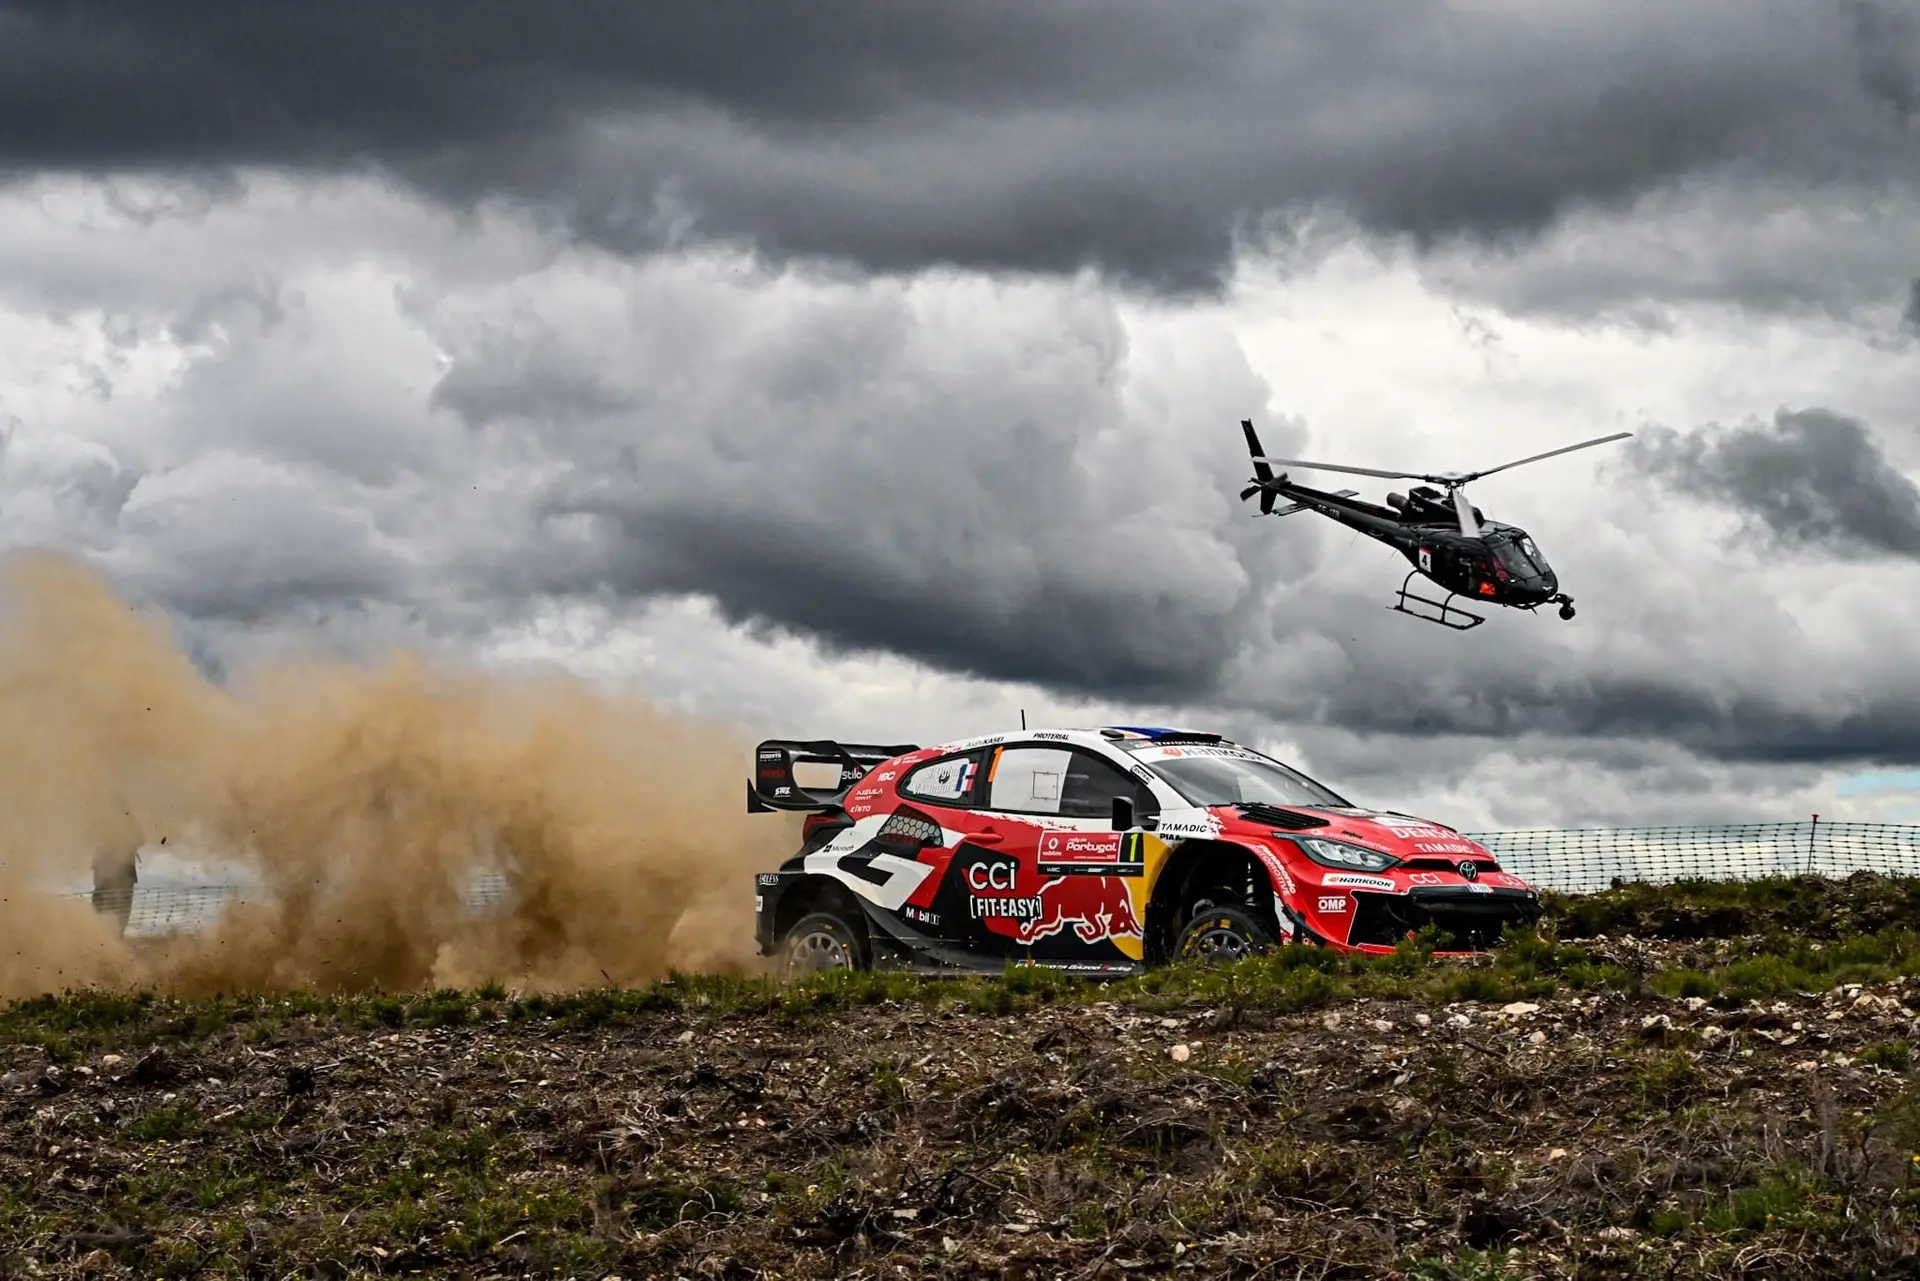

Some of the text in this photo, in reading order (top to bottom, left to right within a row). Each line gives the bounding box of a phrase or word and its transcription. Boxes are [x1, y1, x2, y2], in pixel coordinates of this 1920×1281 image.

[1421, 554, 1429, 566] 4
[1033, 732, 1069, 741] PROTERIAL
[842, 766, 863, 780] Stilo
[1161, 823, 1207, 832] TAMADIC
[1390, 827, 1460, 840] DENSO
[1066, 842, 1117, 853] Portugal
[1130, 834, 1139, 862] 1
[1414, 844, 1474, 854] TAMADIC
[1318, 899, 1346, 910] OMP
[906, 907, 930, 923] Mobil
